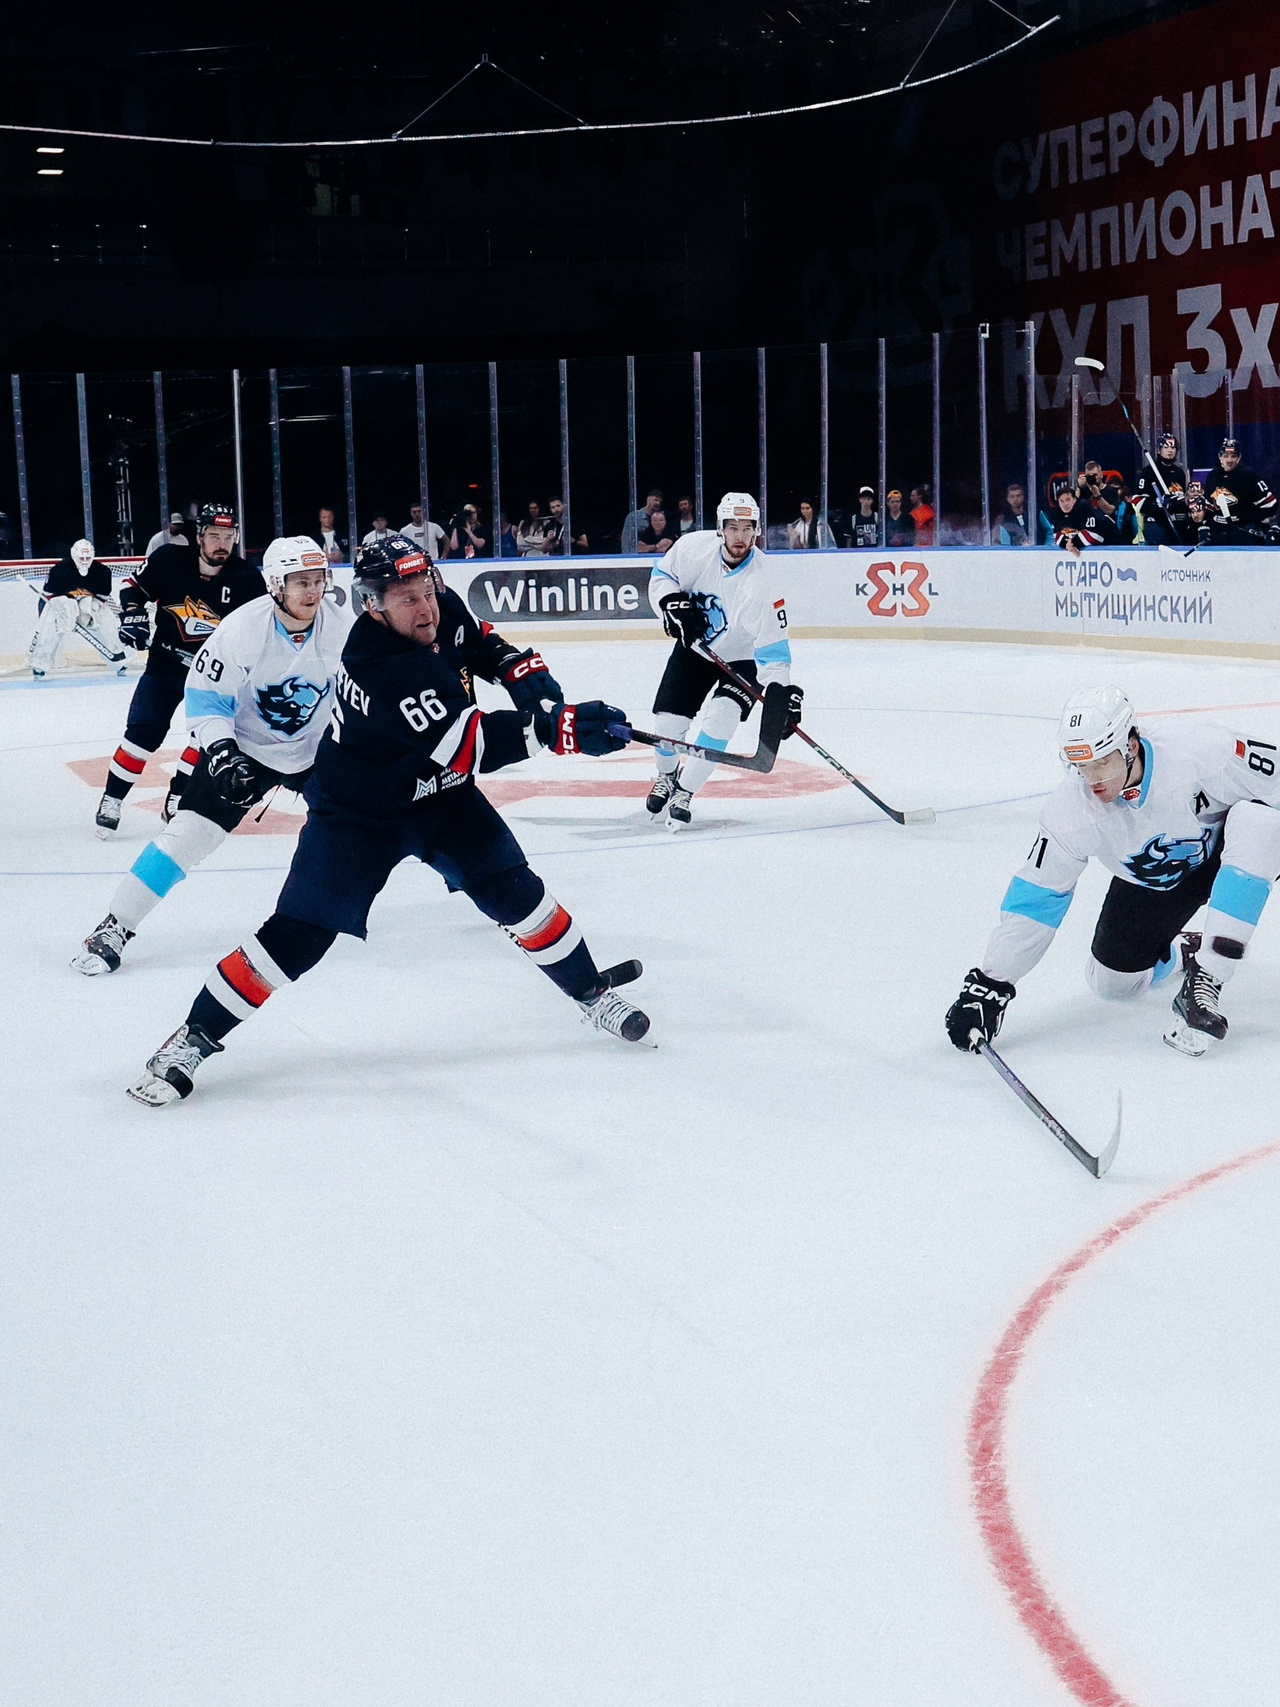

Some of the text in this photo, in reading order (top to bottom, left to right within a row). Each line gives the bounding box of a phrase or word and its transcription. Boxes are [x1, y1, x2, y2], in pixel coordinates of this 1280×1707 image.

[1001, 296, 1152, 412] КХЛ
[399, 557, 425, 572] FONBET
[1055, 561, 1113, 588] СТАРО
[222, 586, 231, 603] C
[484, 577, 639, 613] Winline
[666, 601, 690, 610] CC
[124, 615, 149, 624] BAU
[777, 609, 788, 629] 9
[1055, 591, 1213, 626] МЫТИЩИНСКИЙ
[454, 625, 465, 647] A
[195, 649, 225, 683] 69
[514, 657, 544, 679] CC
[399, 688, 448, 733] 66
[1069, 714, 1083, 728] 81
[562, 711, 575, 754] CM
[1247, 739, 1277, 777] 81
[1192, 789, 1211, 816] A
